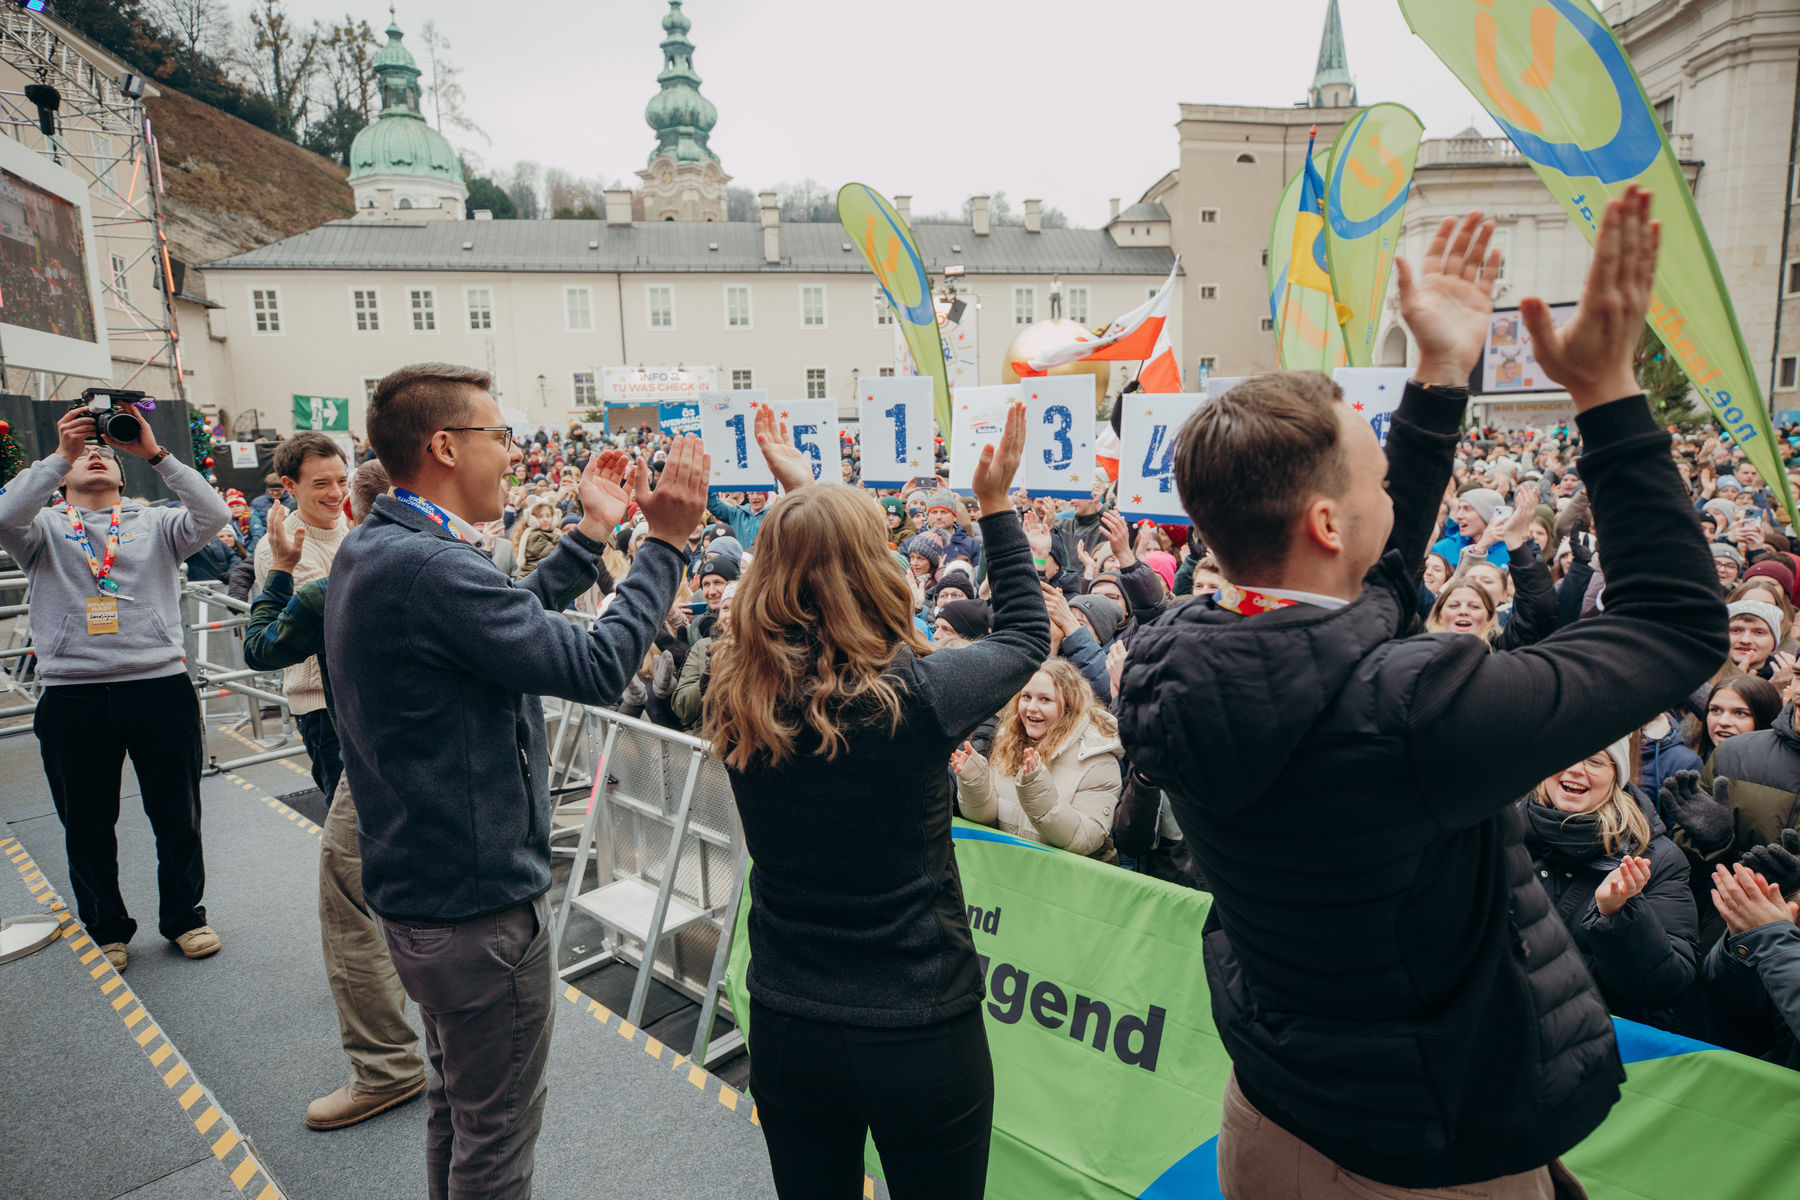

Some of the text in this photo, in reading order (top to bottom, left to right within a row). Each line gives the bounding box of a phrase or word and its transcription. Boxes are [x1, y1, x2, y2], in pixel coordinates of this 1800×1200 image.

[613, 382, 710, 392] TU WAS CHECK-IN
[640, 372, 668, 381] INFO
[725, 414, 748, 469] 1
[792, 424, 822, 481] 5
[885, 403, 907, 464] 1
[1042, 405, 1073, 471] 3
[1142, 425, 1175, 493] 4
